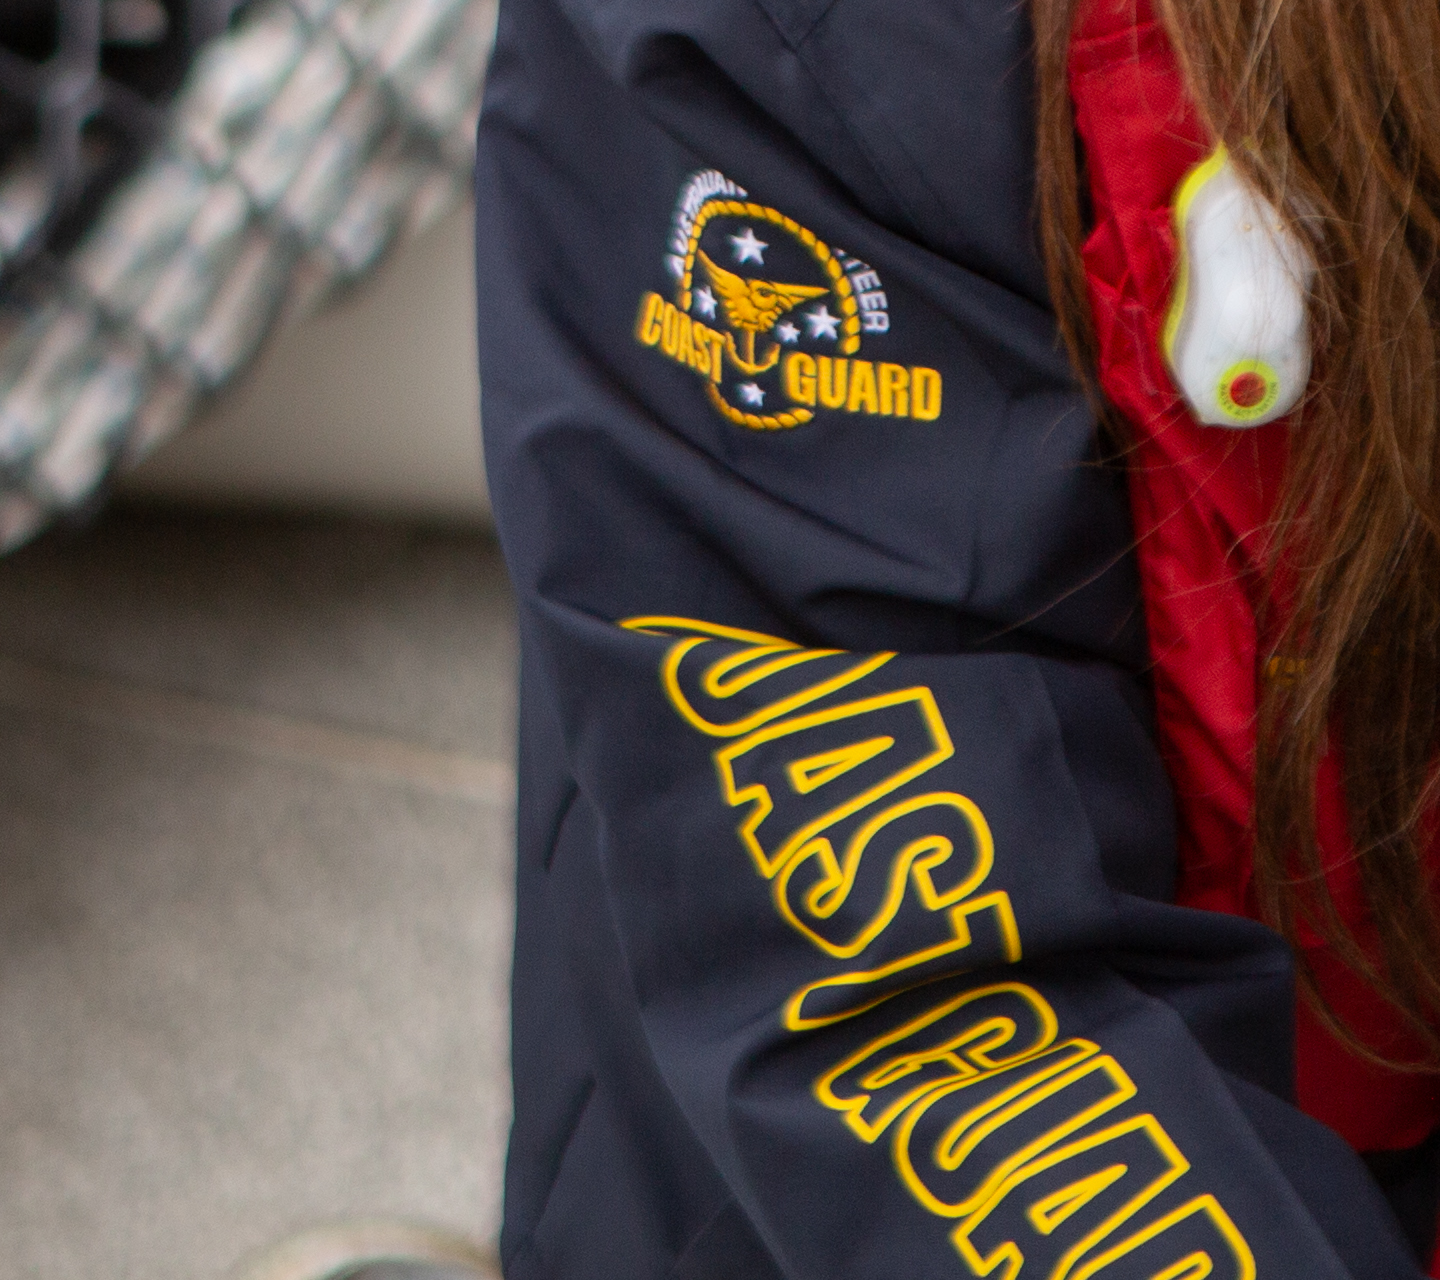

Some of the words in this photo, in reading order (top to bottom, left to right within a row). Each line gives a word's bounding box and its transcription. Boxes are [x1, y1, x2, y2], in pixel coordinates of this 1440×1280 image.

[635, 290, 728, 383] COAST
[781, 351, 943, 422] GUARD
[618, 614, 1023, 1032] OAST
